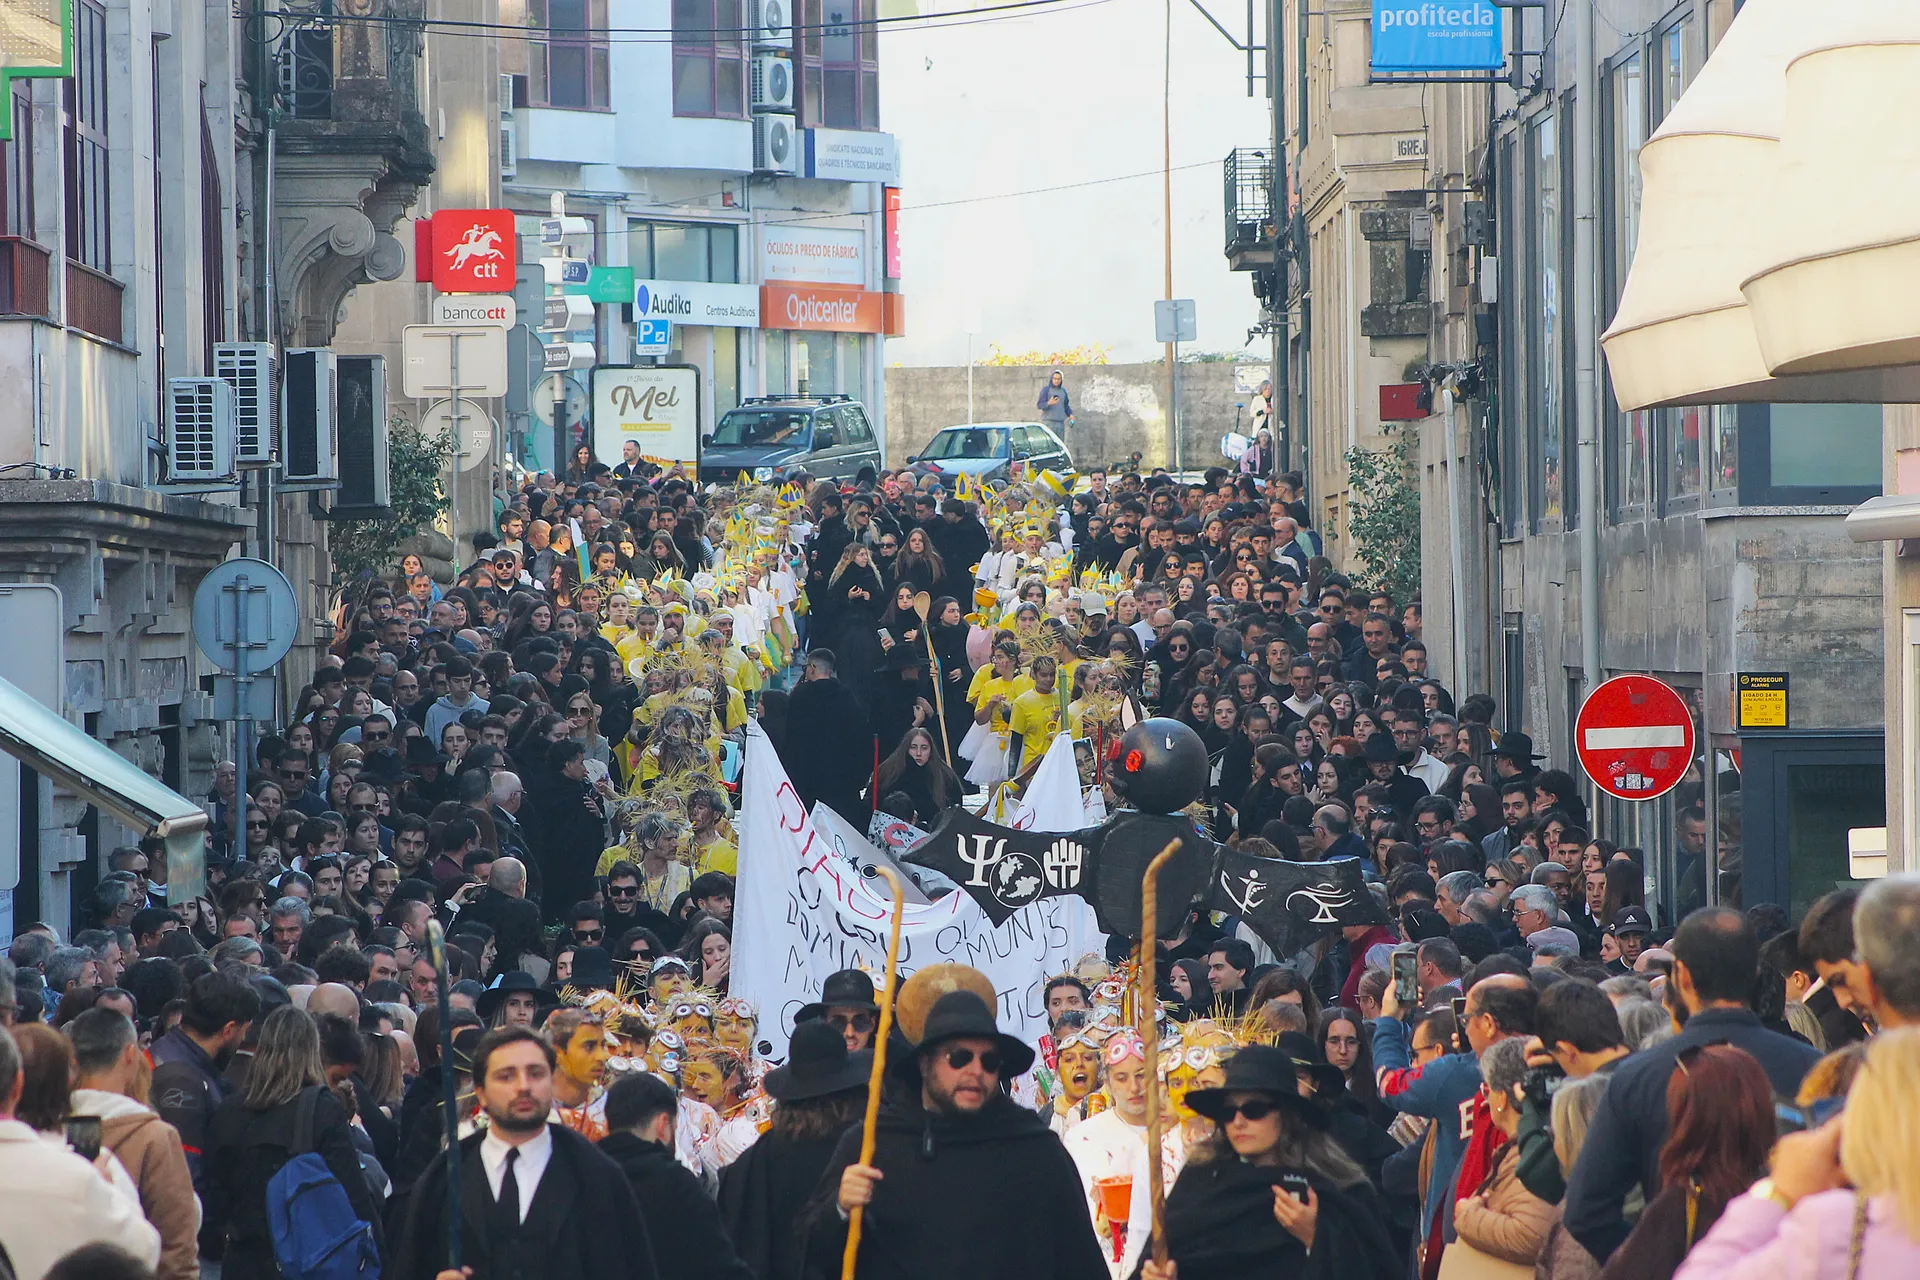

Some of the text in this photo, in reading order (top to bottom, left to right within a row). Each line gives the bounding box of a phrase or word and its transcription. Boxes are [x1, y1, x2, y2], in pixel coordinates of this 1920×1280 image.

[1380, 3, 1494, 32] profitecla
[1451, 29, 1493, 38] profissional
[850, 146, 874, 155] NACIONAL
[874, 147, 884, 156] DOS
[818, 158, 840, 168] QUADROS
[767, 239, 859, 260] ÓCULOS A PREÇO DE FÁBRICA
[473, 262, 498, 278] ctt
[651, 293, 691, 315] Audika
[706, 304, 756, 318] Centros Auditivos
[786, 293, 857, 328] Opticenter
[640, 321, 654, 342] P
[611, 385, 680, 421] Mel
